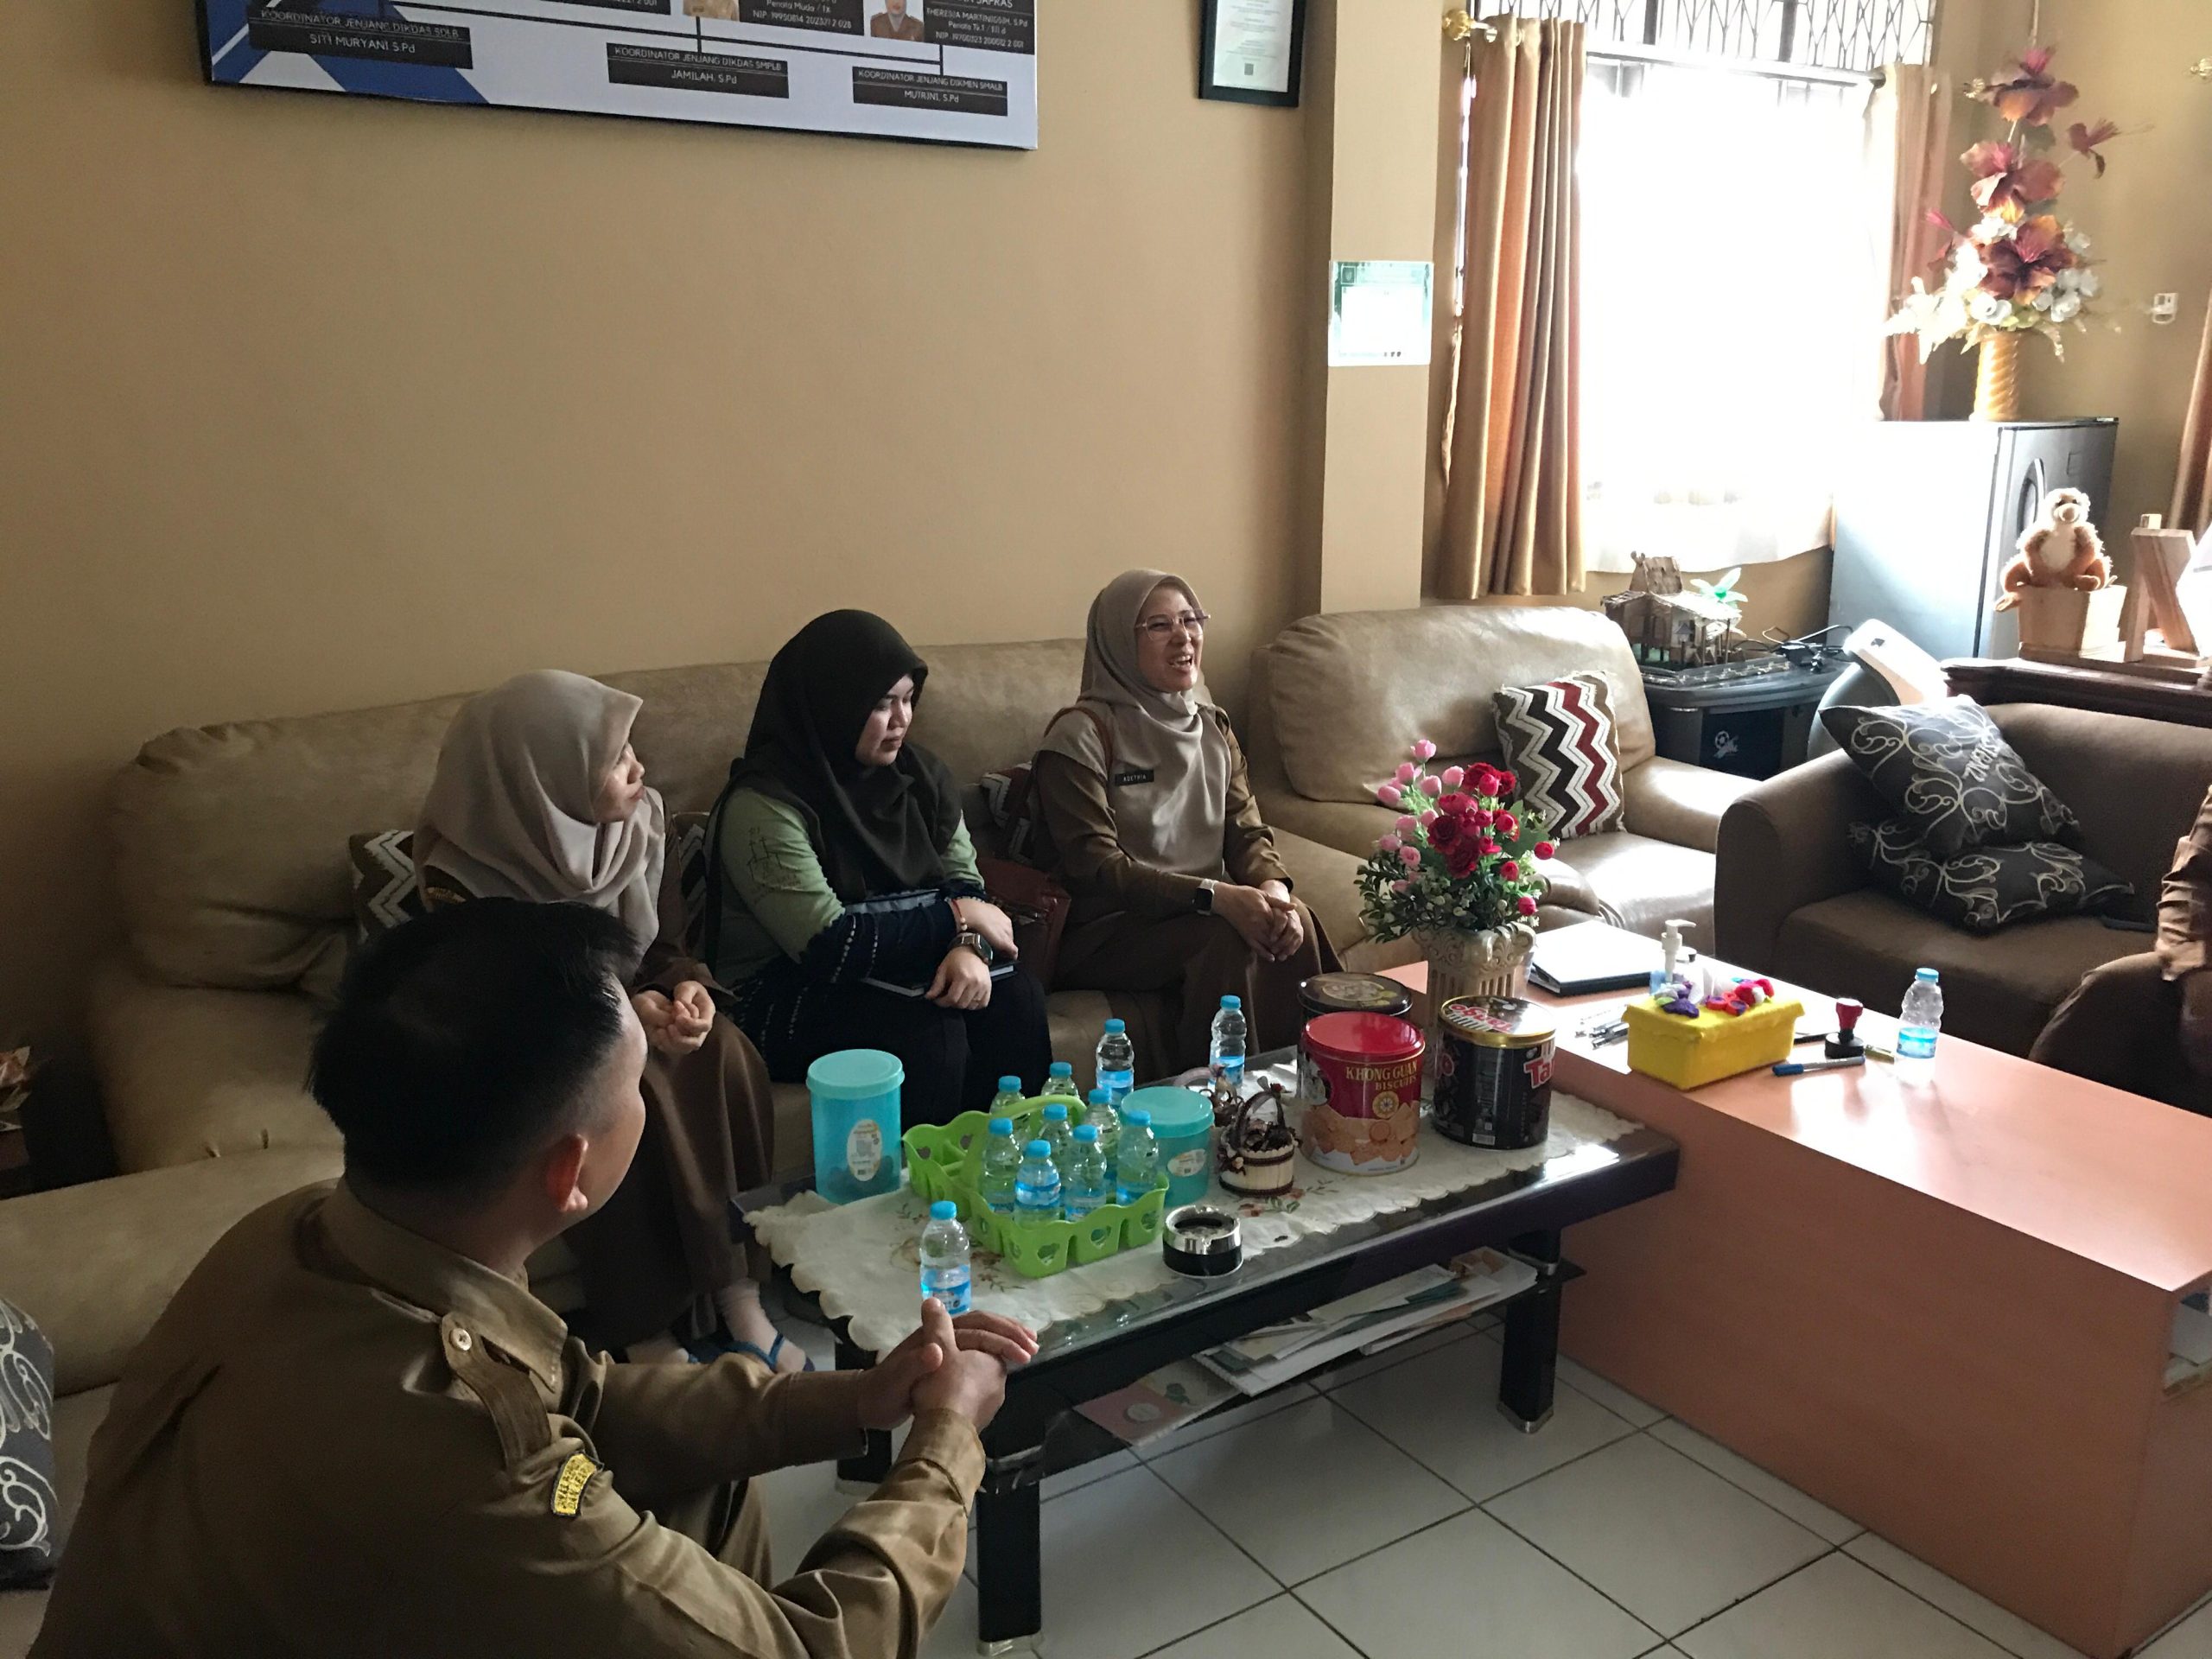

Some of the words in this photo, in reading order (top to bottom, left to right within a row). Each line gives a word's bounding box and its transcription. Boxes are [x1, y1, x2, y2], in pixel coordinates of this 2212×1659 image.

[261, 10, 340, 26] KOORDINATOR
[345, 17, 390, 31] JENJANG
[392, 22, 431, 35] DIKDAS
[309, 34, 332, 45] SITI
[335, 36, 389, 51] MURYANI
[615, 47, 679, 60] KOORDINATOR
[683, 53, 721, 66] JENJANG
[722, 57, 753, 69] DIKDAS
[755, 61, 782, 72] SMPLB
[858, 70, 914, 82] KOORDINATOR
[916, 76, 948, 86] JENJANG
[950, 79, 978, 90] DIKMEN
[979, 82, 1003, 92] SMALB
[1345, 1065, 1390, 1082] KHONG
[1392, 1060, 1417, 1079] GUAN
[1523, 1056, 1554, 1089] Ta
[1375, 1076, 1417, 1090] BISCUITS
